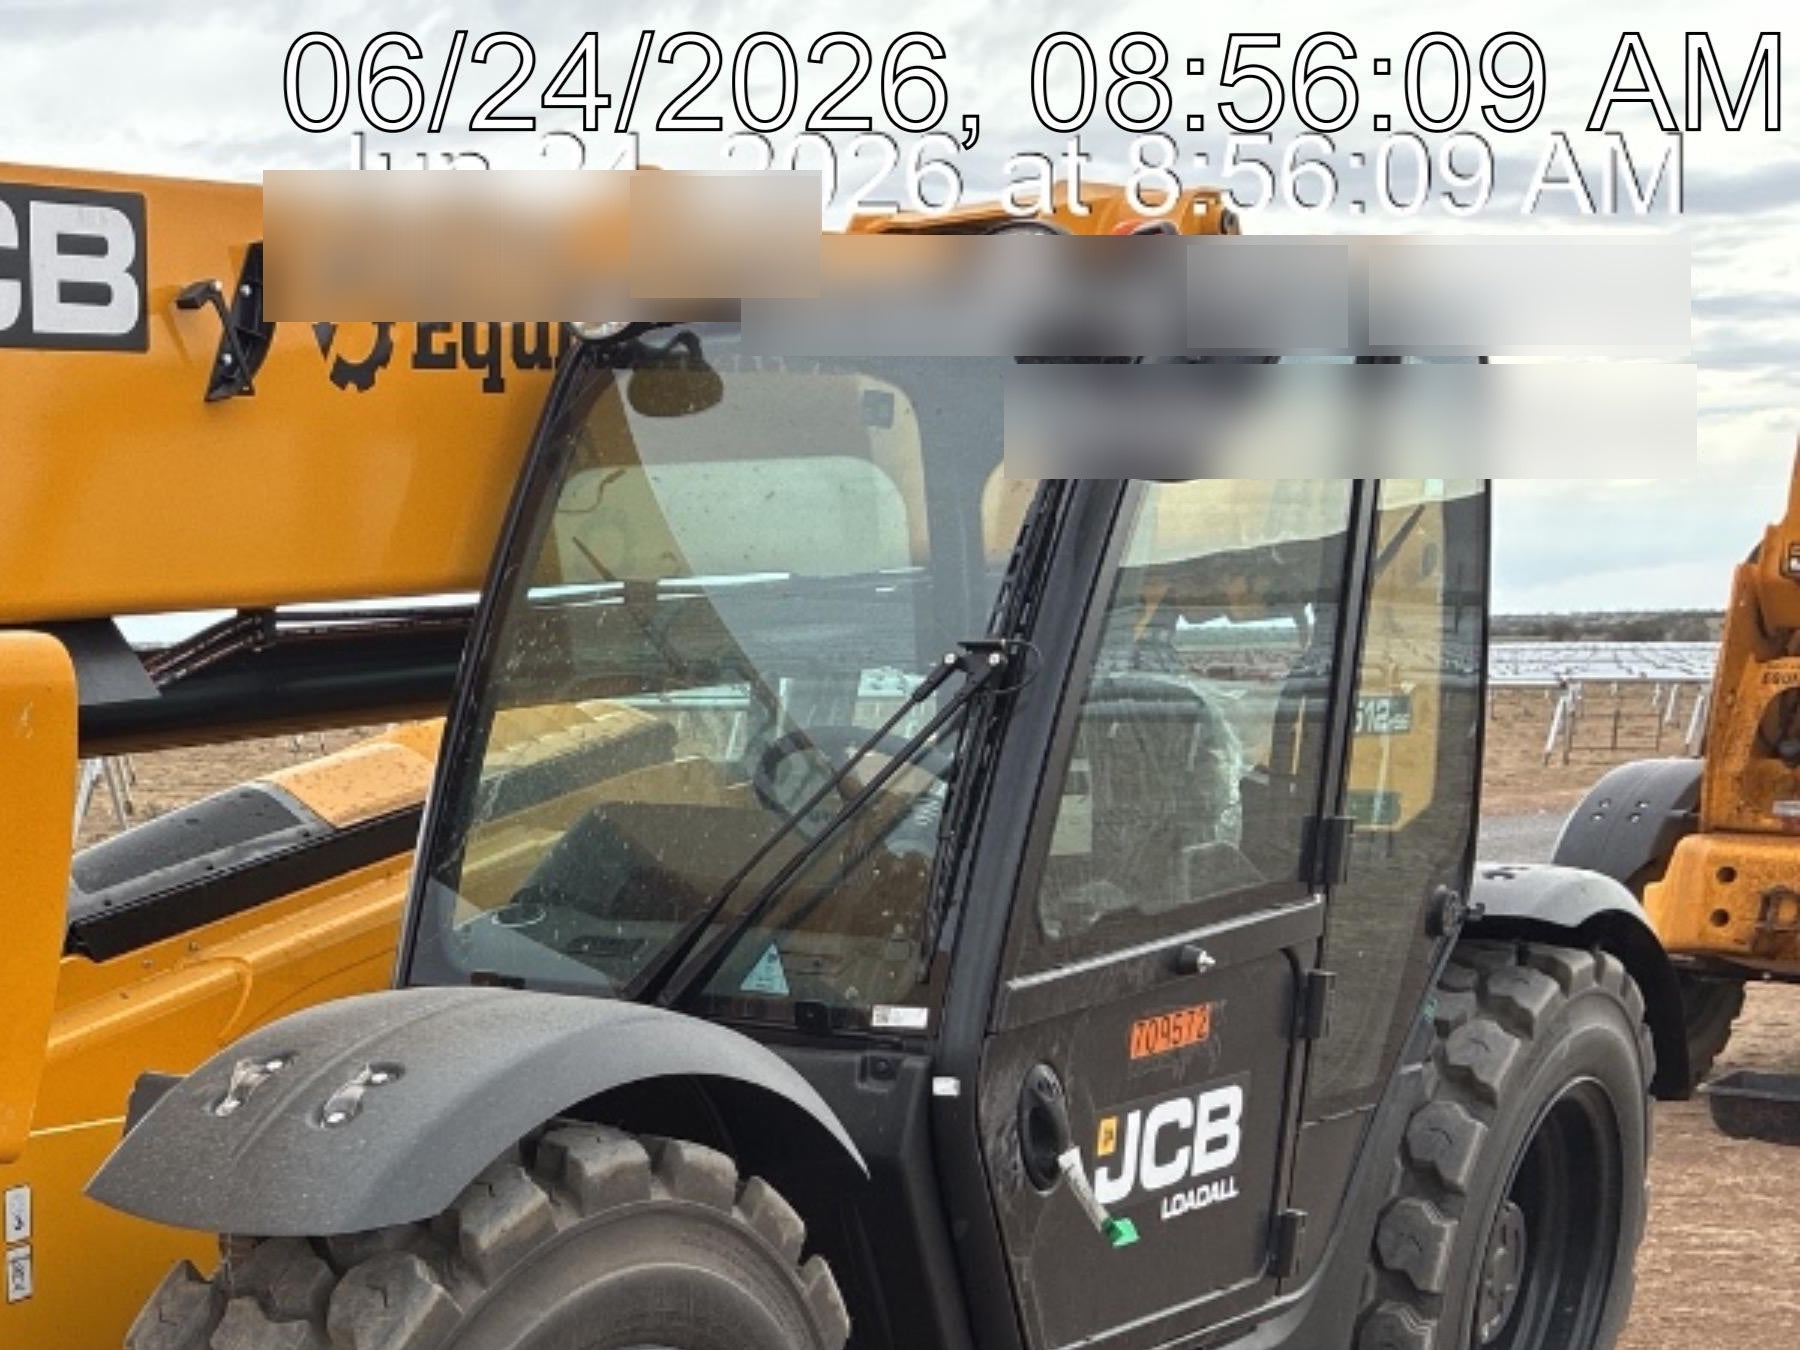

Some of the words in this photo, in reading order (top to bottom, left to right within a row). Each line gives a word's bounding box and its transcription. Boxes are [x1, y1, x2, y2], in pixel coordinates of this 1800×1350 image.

[1134, 1003, 1207, 1056] 709572
[1094, 1084, 1243, 1204] JCB
[1160, 1176, 1239, 1220] LOADALL
